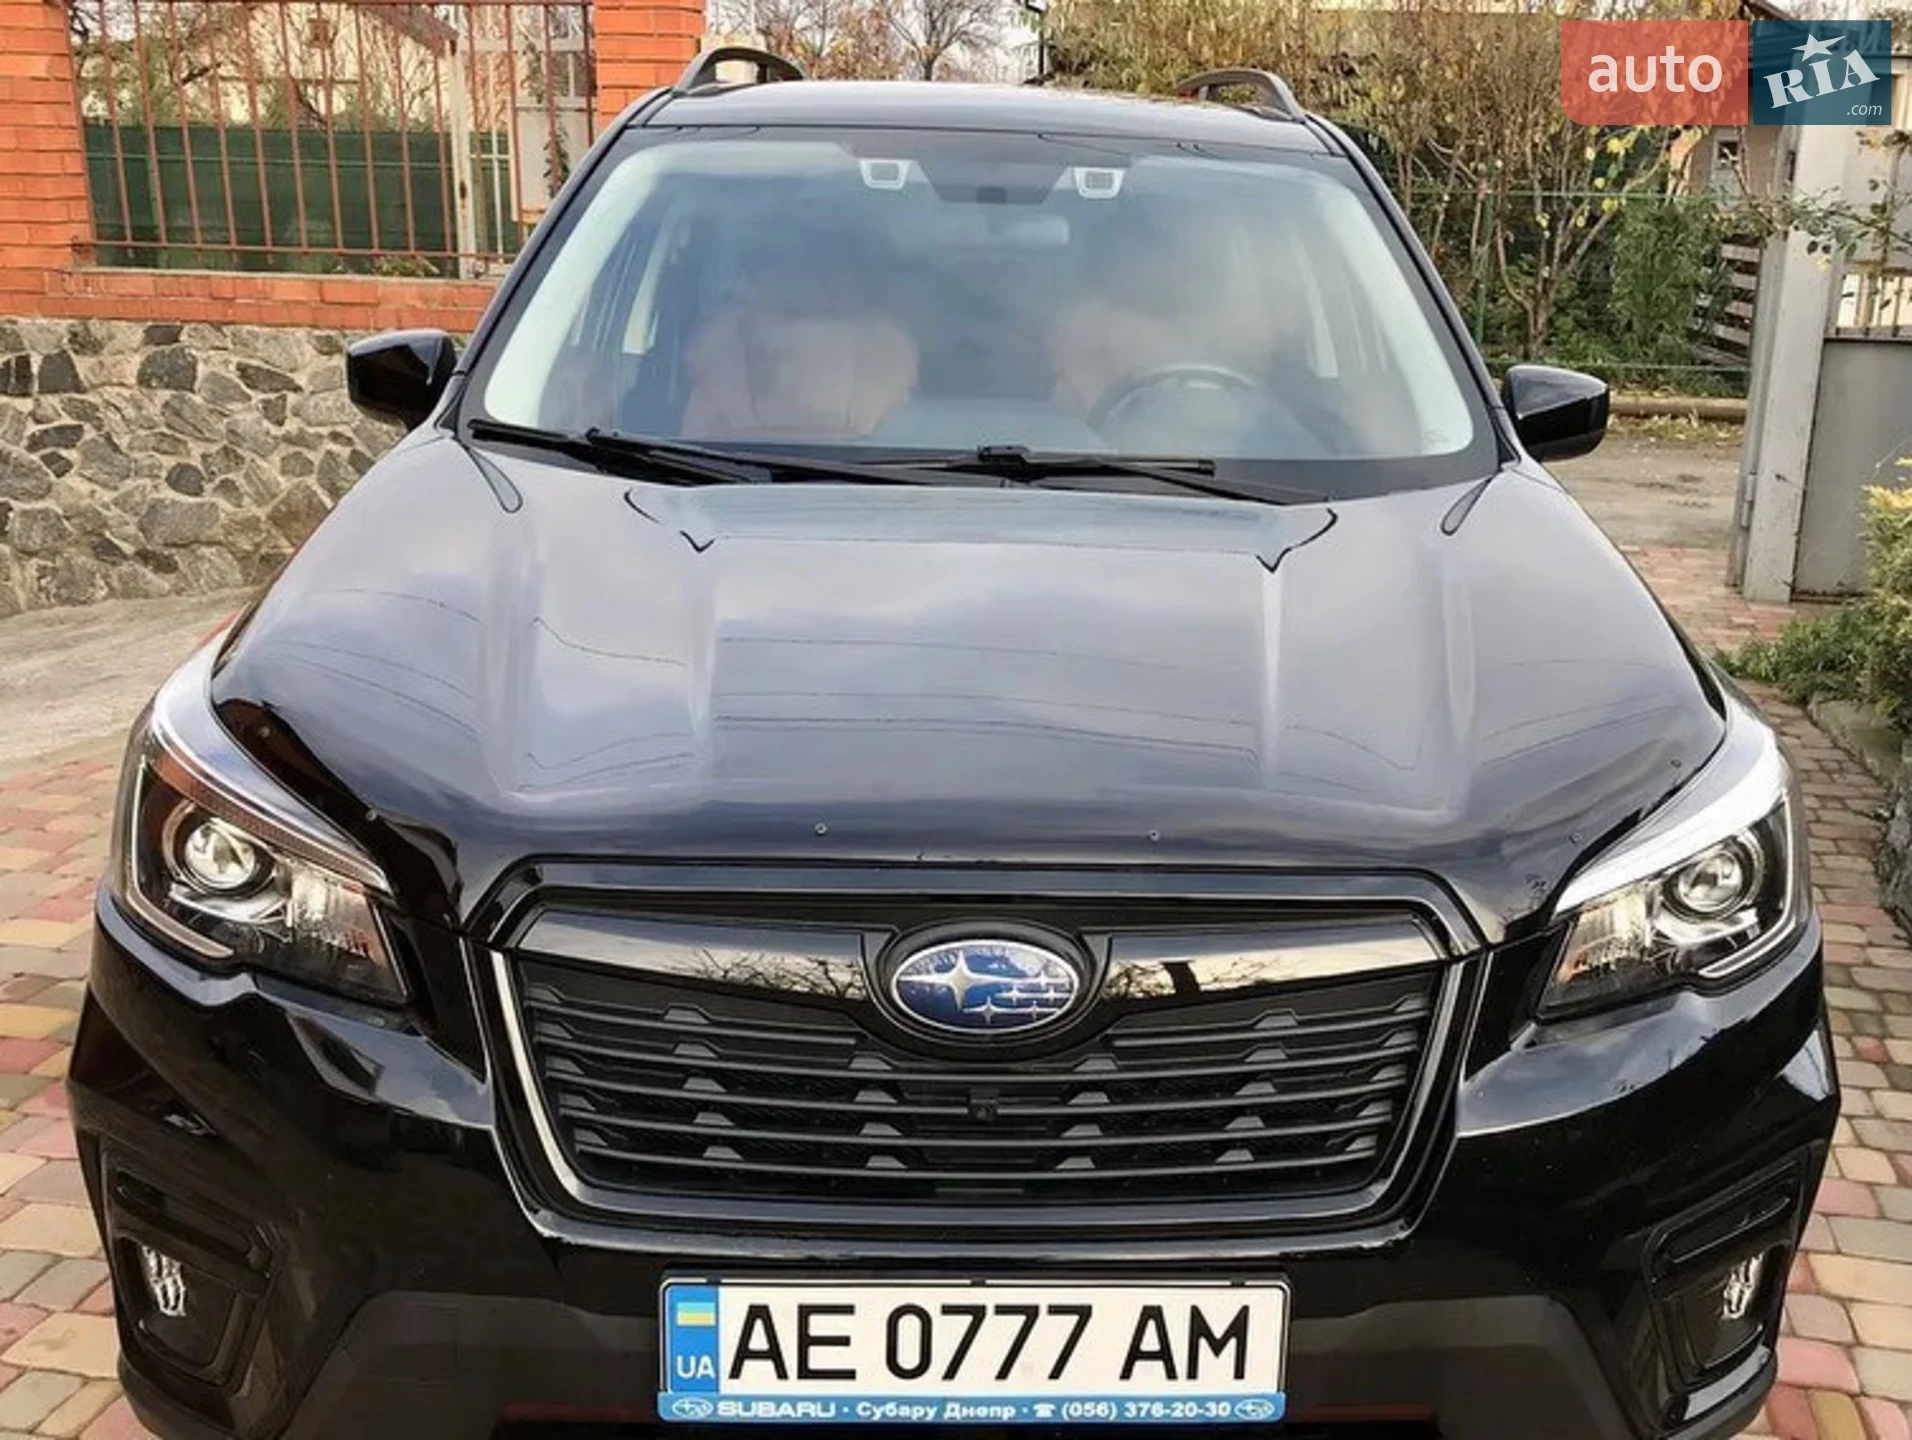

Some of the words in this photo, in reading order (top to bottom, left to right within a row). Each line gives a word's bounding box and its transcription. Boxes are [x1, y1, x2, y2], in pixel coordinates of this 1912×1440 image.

[728, 1304, 857, 1380] AE
[886, 1303, 1093, 1380] 0777
[1119, 1304, 1250, 1380] AM
[676, 1355, 716, 1379] UA
[716, 1401, 836, 1418] SUBARU
[855, 1402, 937, 1420] Субару
[943, 1402, 1016, 1420] Днепр
[1060, 1401, 1118, 1420] (056)
[1123, 1401, 1231, 1418] 376-20-30
